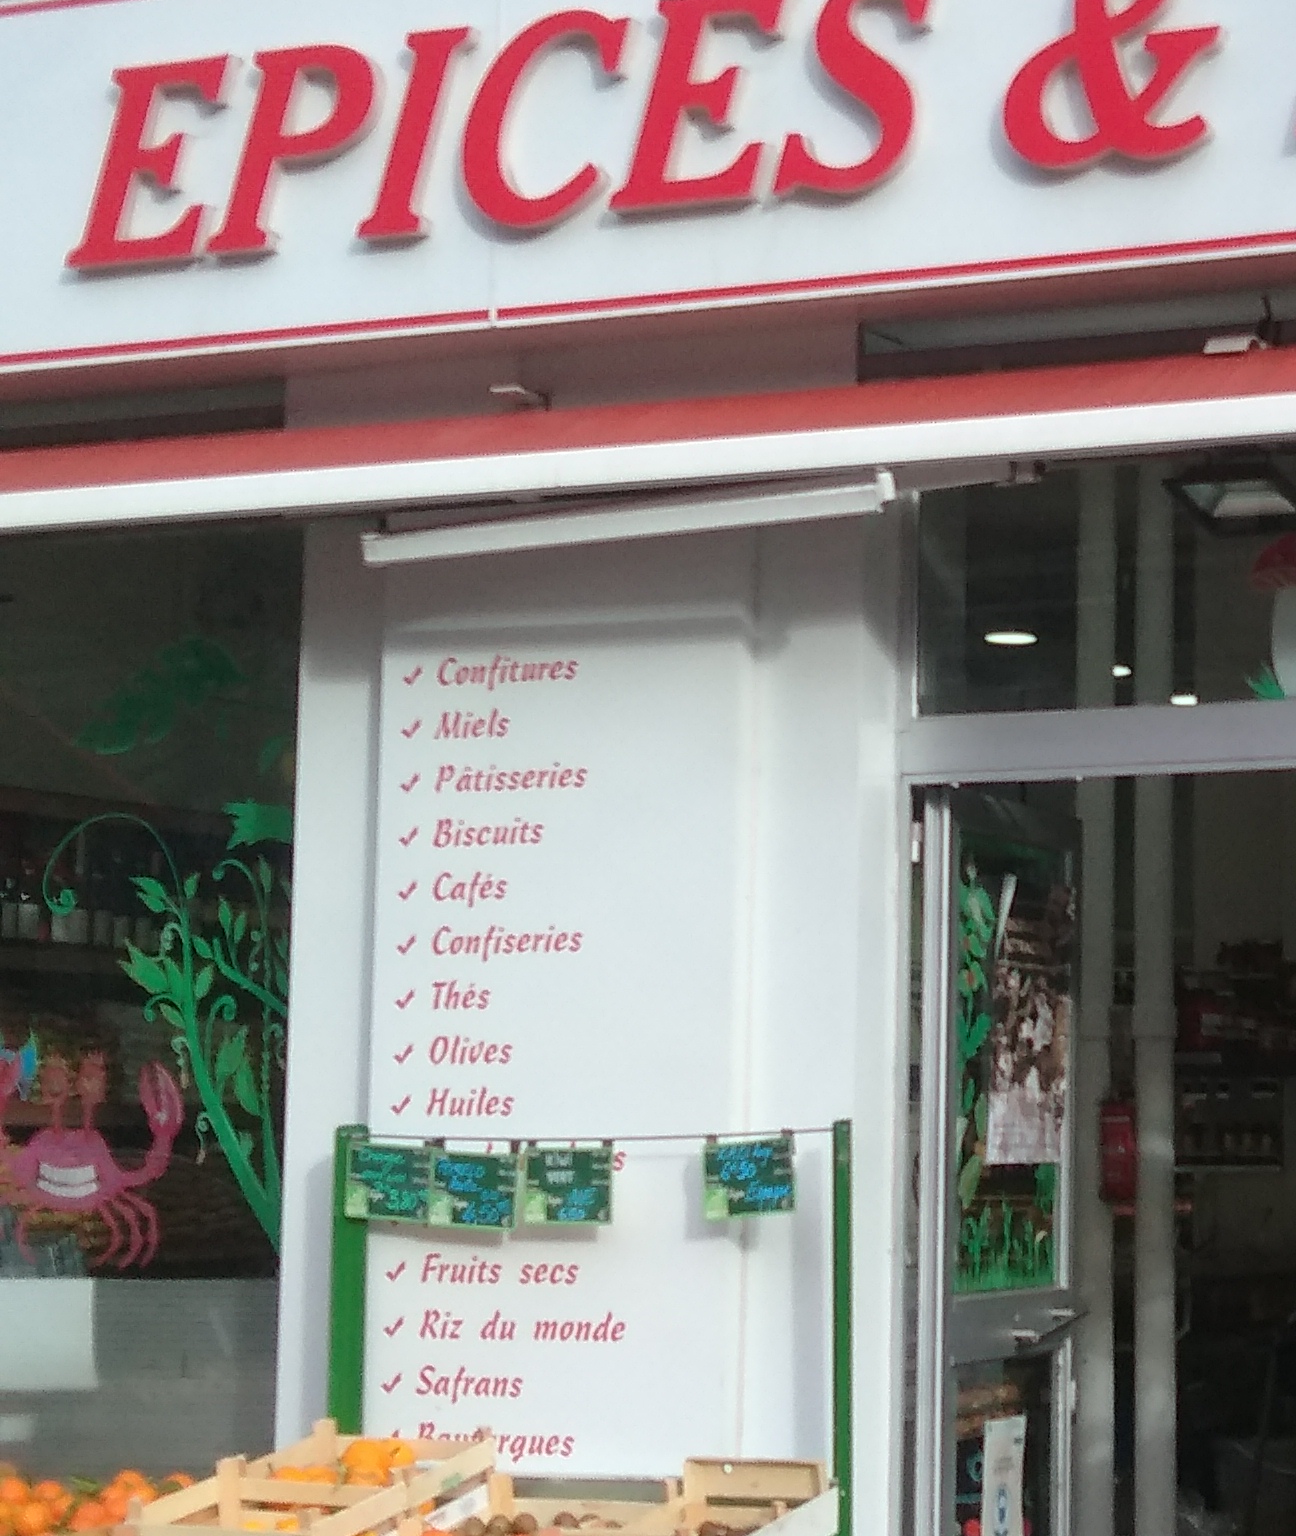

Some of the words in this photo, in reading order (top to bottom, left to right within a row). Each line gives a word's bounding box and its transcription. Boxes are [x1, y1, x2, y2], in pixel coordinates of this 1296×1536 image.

[437, 655, 577, 691] Confitures
[434, 709, 510, 739] Miels
[434, 763, 586, 793] Pâtisseries
[432, 818, 544, 849] Biscuits
[431, 871, 508, 907] Cafés
[430, 925, 583, 961] Confiseries
[431, 980, 491, 1010] Thés
[428, 1035, 513, 1065] Olives
[425, 1087, 515, 1117] Huiles
[420, 1251, 502, 1286] Fruits
[519, 1262, 579, 1286] secs
[418, 1308, 464, 1342] Riz
[479, 1310, 517, 1342] du
[532, 1311, 627, 1343] monde
[414, 1363, 525, 1404] Safrans
